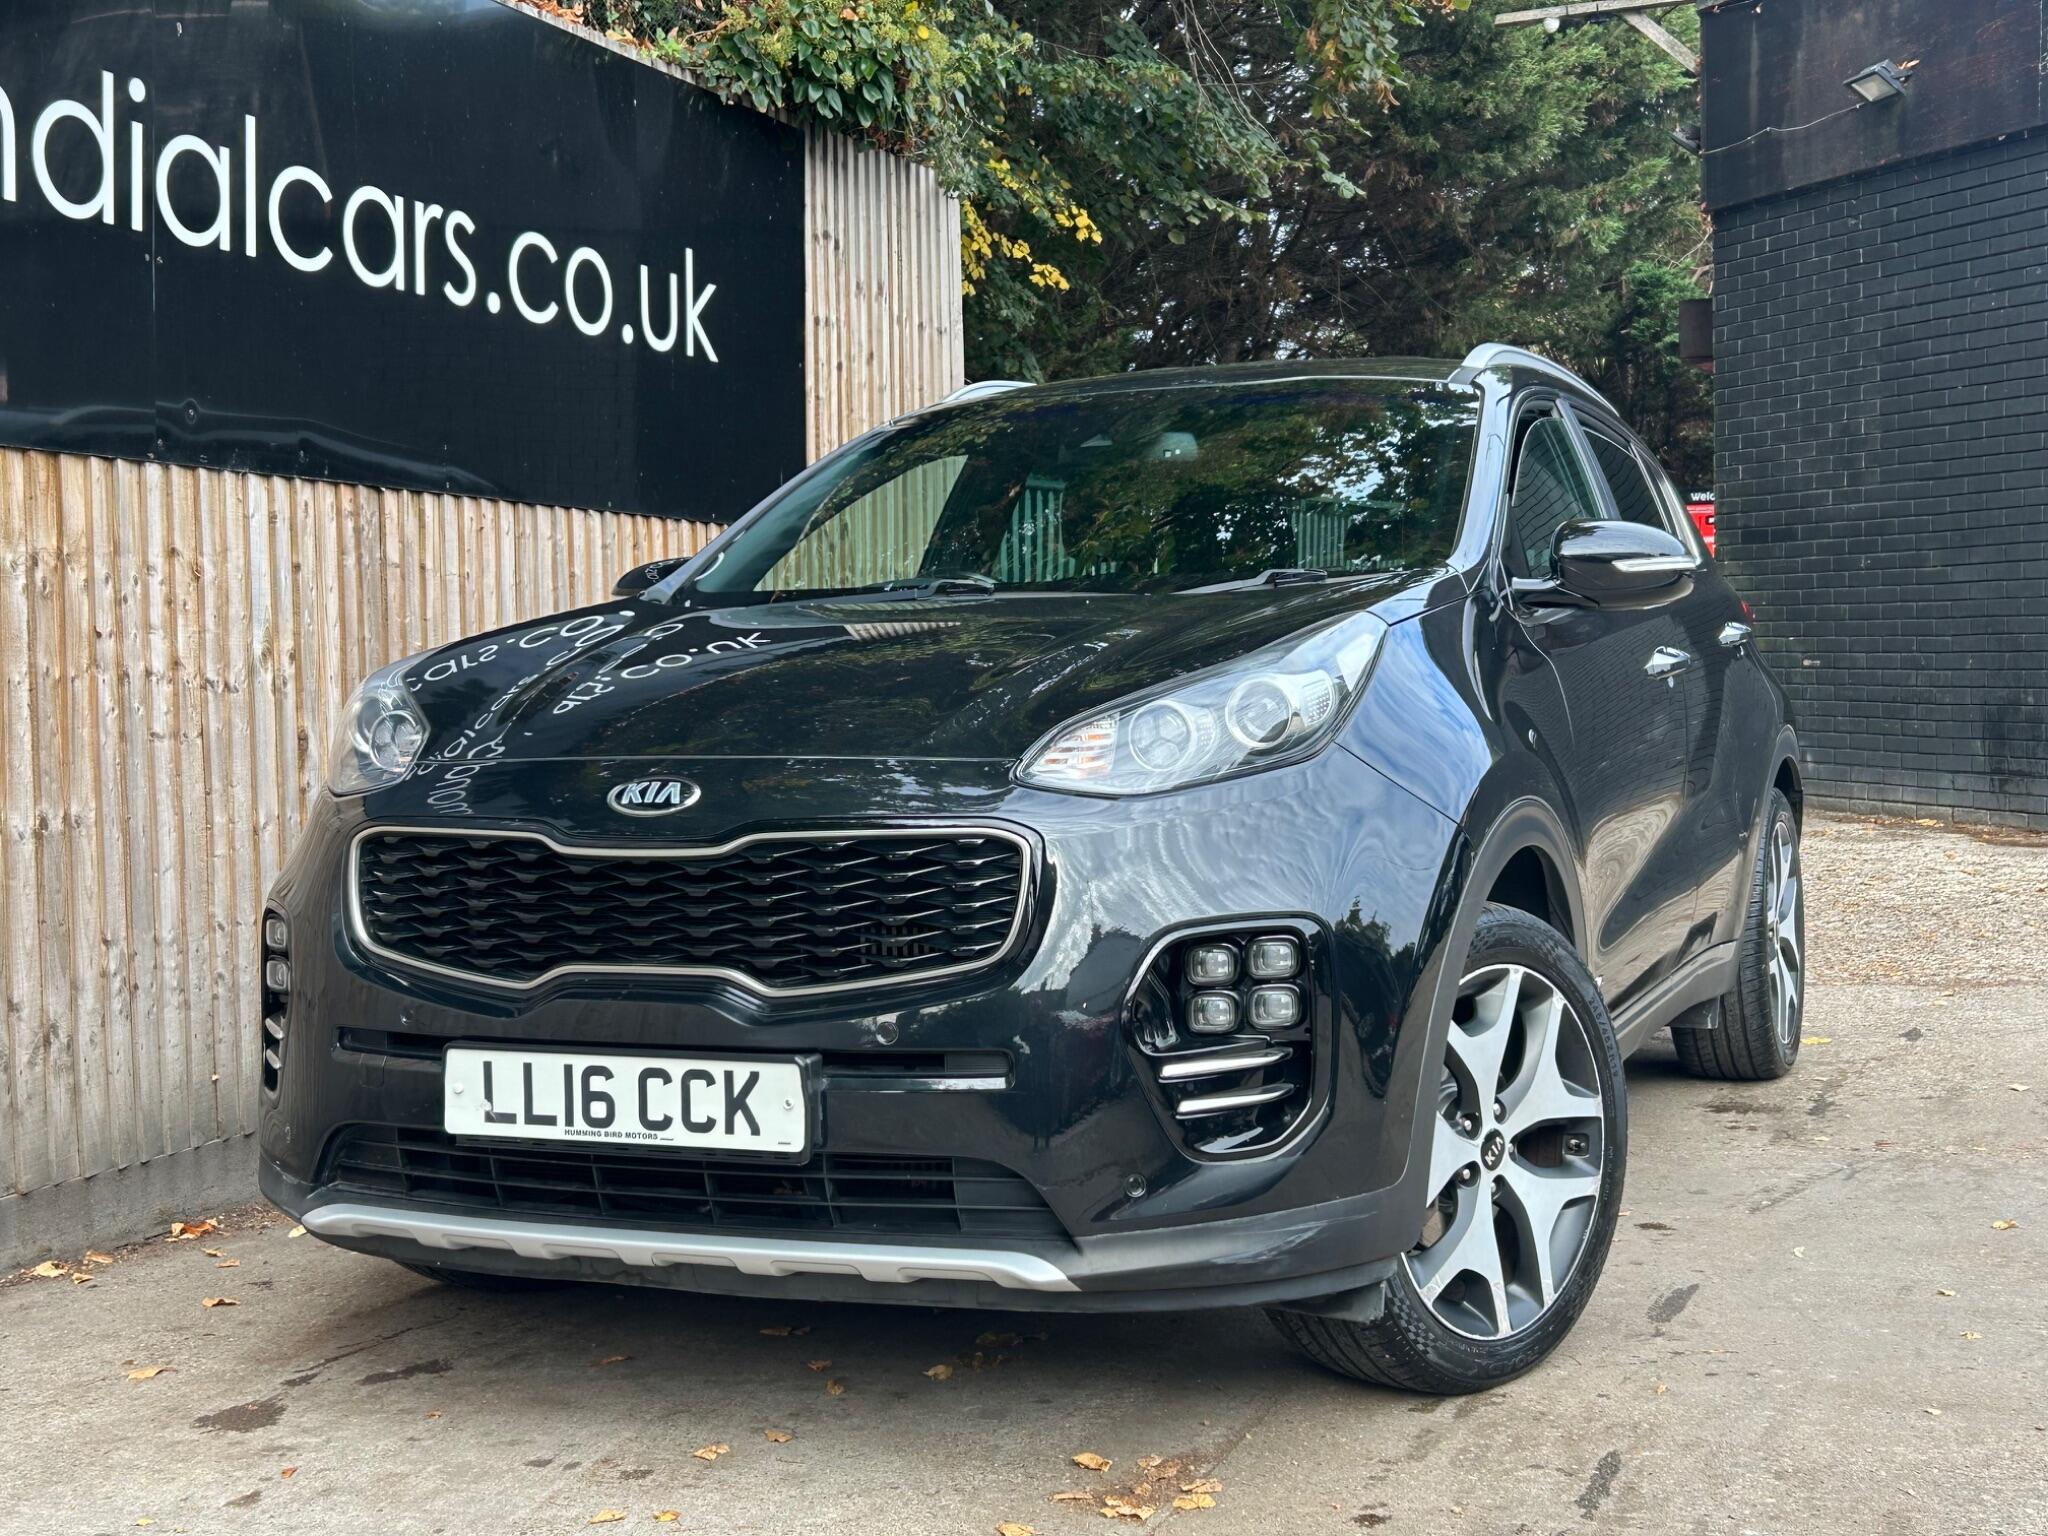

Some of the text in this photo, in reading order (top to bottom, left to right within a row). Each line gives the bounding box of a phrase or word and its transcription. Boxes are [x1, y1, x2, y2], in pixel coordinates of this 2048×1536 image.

[620, 781, 682, 805] KIA
[482, 1060, 761, 1137] LL16 CCK
[563, 1128, 659, 1140] HUMMING BIRD MOTORS
[1484, 1136, 1504, 1166] KIA
